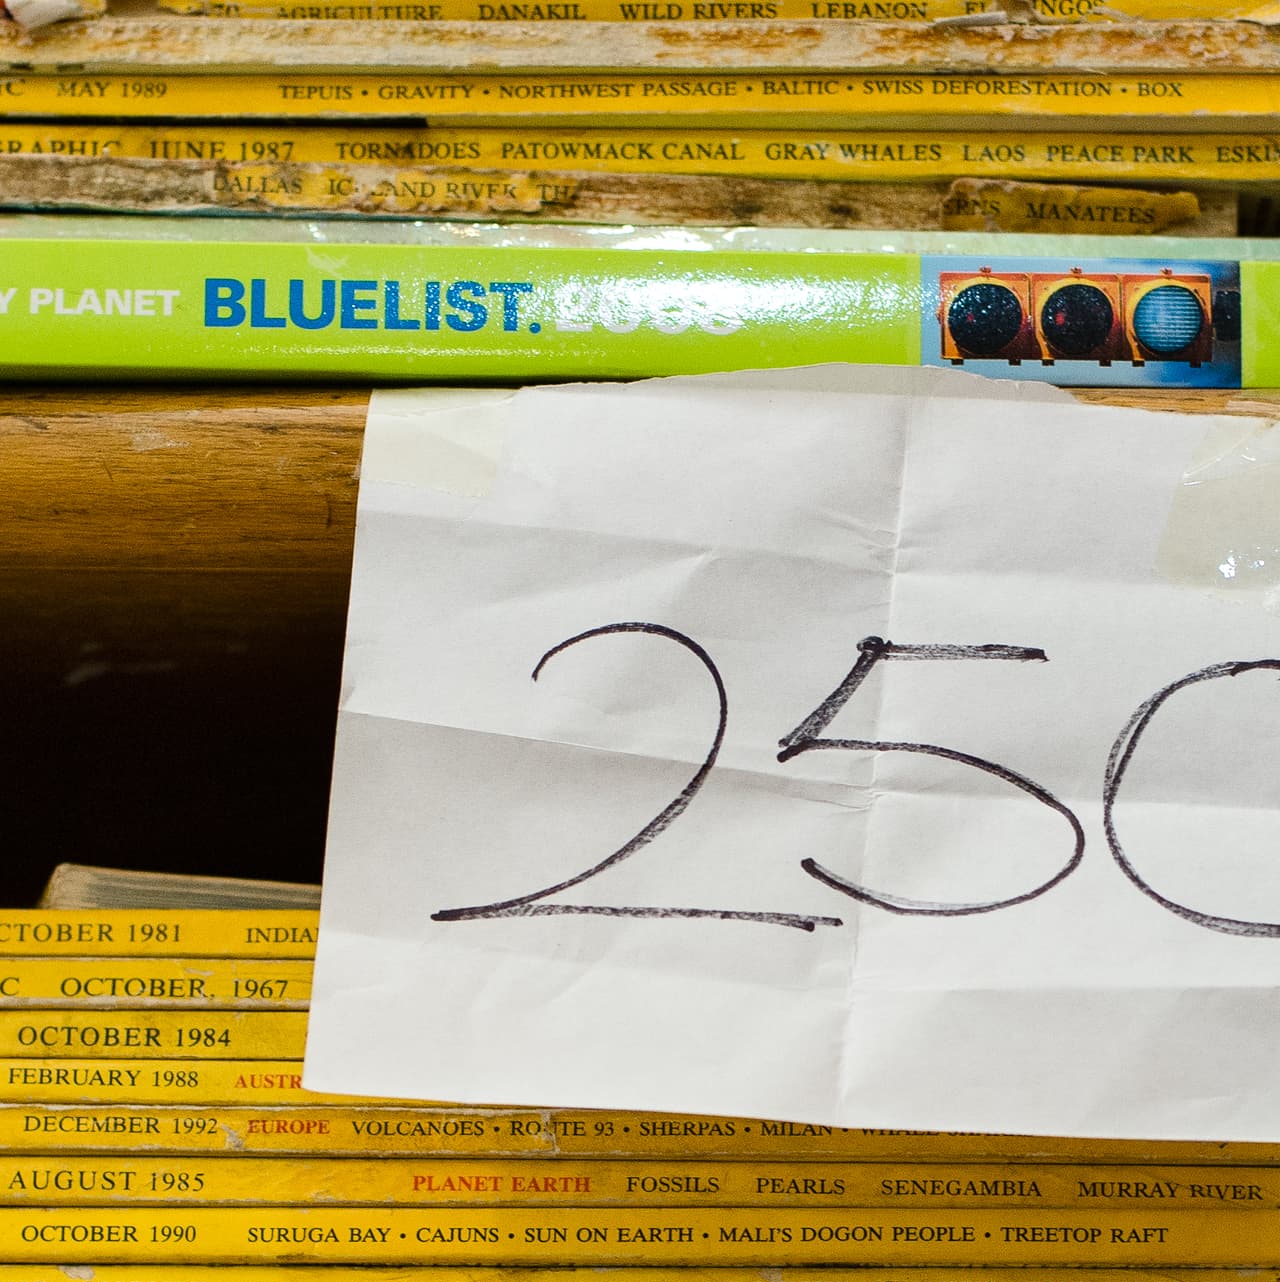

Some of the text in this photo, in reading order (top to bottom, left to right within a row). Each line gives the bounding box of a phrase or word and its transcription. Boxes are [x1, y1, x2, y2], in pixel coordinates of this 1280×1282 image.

[478, 3, 587, 21] DANAKIL
[620, 2, 683, 20] WILD
[692, 2, 778, 19] RIVERS
[812, 2, 928, 19] LEBANON
[57, 81, 111, 98] MAY
[121, 81, 168, 99] 1989
[279, 84, 353, 101] TEPUIS
[377, 84, 475, 101] GRAVITY
[499, 82, 635, 100] NORTHWEST
[643, 80, 738, 98] PASSAGE
[763, 79, 839, 96] BALTIC
[862, 79, 925, 96] SWISS
[932, 79, 1113, 98] DEFORESTATION
[1137, 81, 1184, 98] BOX
[239, 141, 294, 161] 1987
[335, 141, 481, 160] TORNADOES
[501, 142, 654, 161] PATOWMACK
[661, 142, 745, 161] CANAL
[765, 142, 829, 162] GRAY
[840, 143, 942, 162] WHALES
[963, 143, 1026, 162] LAOS
[1046, 144, 1123, 163] PEACE
[1132, 145, 1196, 164] PARK
[214, 175, 303, 195] DALLAS
[1026, 204, 1156, 225] MANATEES
[28, 287, 181, 318] PLANET
[203, 277, 543, 335] BLUELIST.
[129, 924, 180, 942] 1981
[246, 927, 320, 944] INDIA
[17, 1026, 162, 1047] OCTOBER
[176, 1028, 231, 1047] 1984
[21, 1225, 139, 1242] OCTOBER
[151, 1225, 197, 1242] 1990
[247, 1227, 340, 1244] SURUGA
[348, 1228, 391, 1243] BAY
[415, 1227, 500, 1243] CAJUNS
[524, 1228, 568, 1243] SUN
[575, 1227, 609, 1243] ON
[616, 1227, 694, 1243] EARTH
[718, 1227, 793, 1243] MALI'S
[800, 1226, 884, 1242] DOGON
[891, 1226, 976, 1242] PEOPLE
[999, 1226, 1103, 1243] TREETOP
[1110, 1227, 1170, 1243] RAFT
